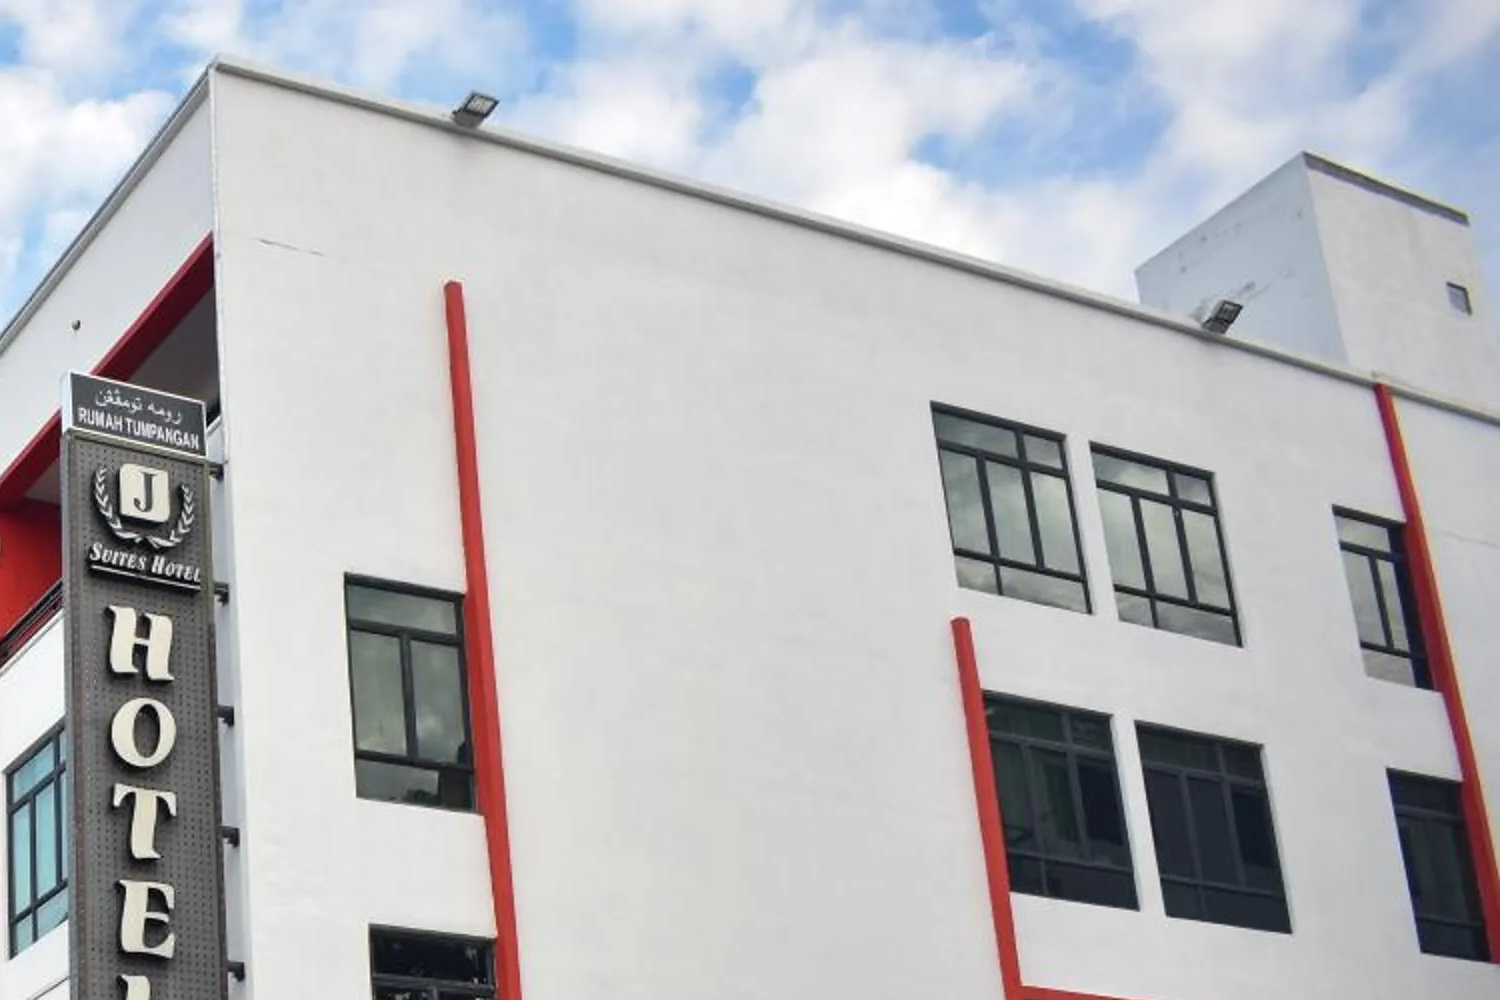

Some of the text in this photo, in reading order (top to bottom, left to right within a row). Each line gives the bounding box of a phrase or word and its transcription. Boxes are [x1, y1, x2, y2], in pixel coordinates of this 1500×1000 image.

[77, 407, 199, 450] RUMAH TUMPANGAN
[133, 471, 156, 513] J
